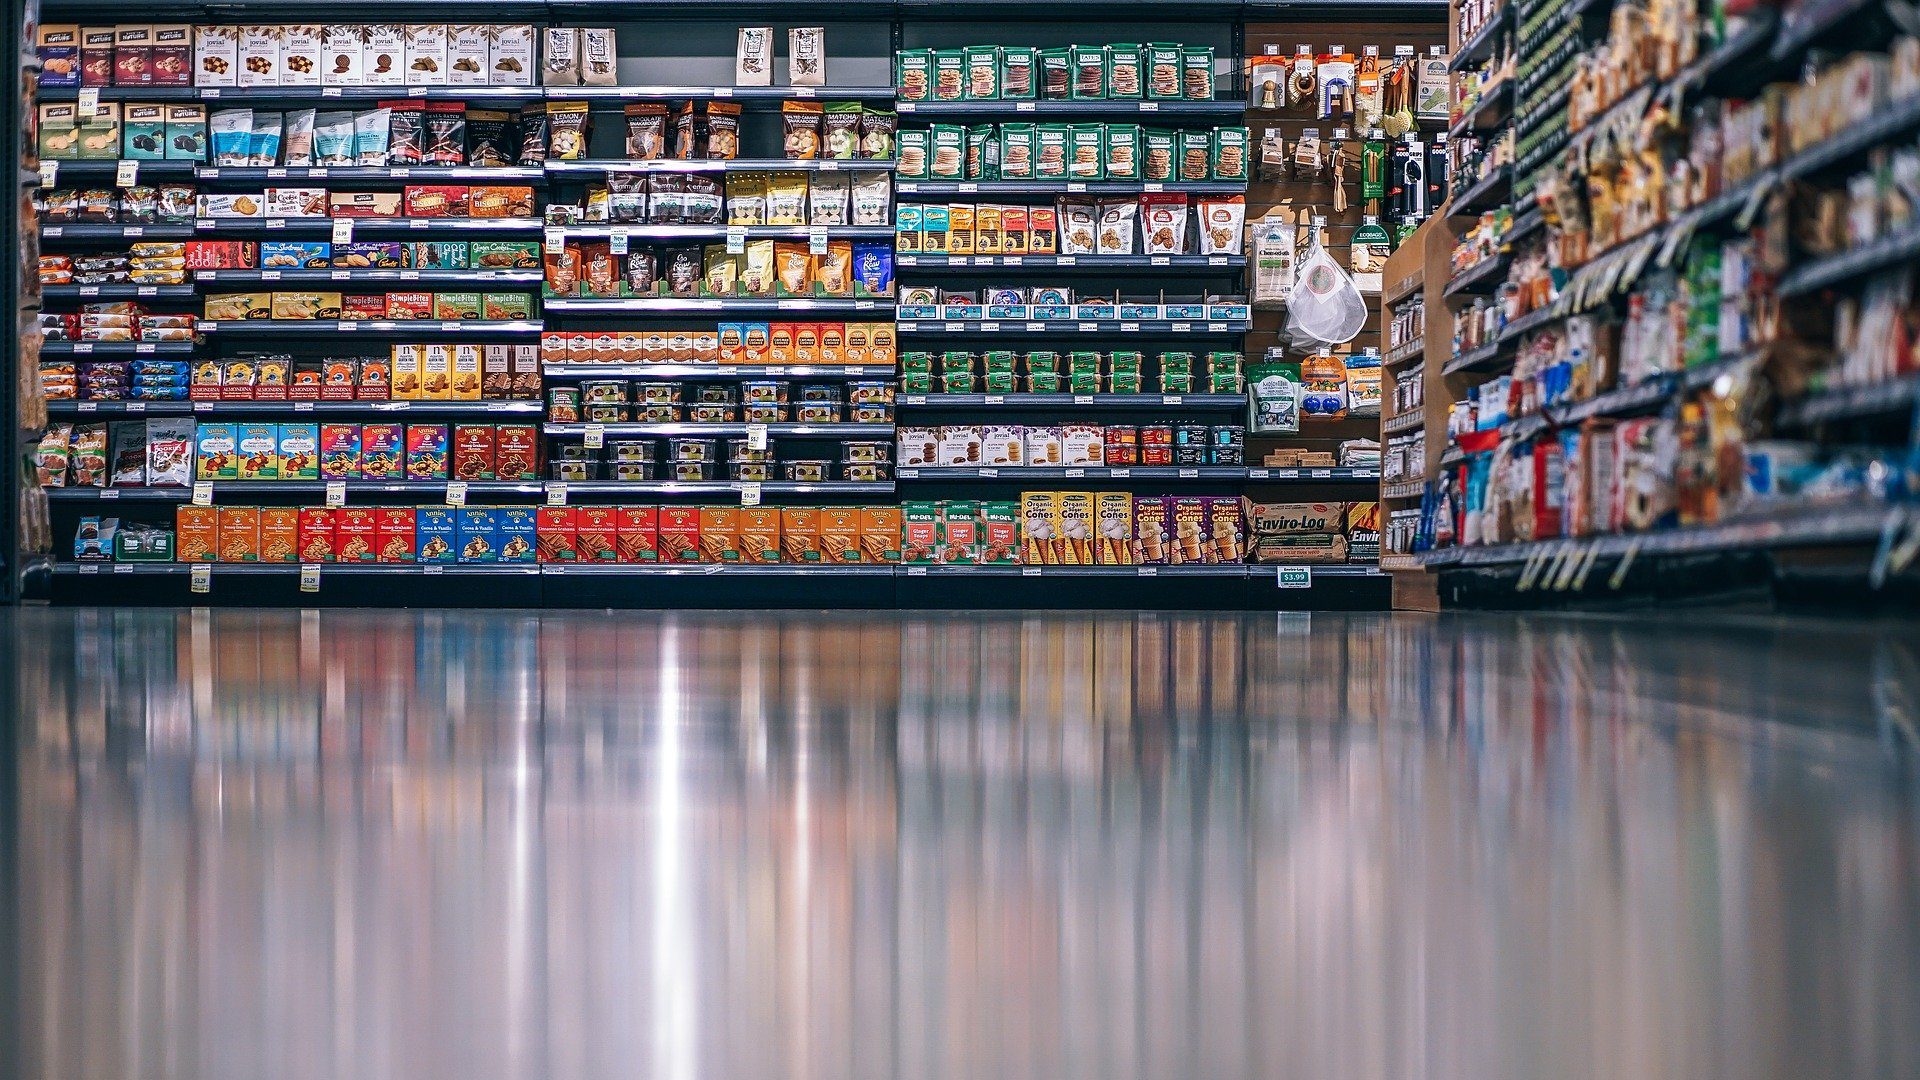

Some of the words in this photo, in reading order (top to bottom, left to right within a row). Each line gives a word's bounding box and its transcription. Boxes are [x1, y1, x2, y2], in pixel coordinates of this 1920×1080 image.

[291, 38, 309, 46] jovial
[333, 38, 351, 46] jovial
[375, 38, 393, 46] jovial
[417, 38, 435, 46] jovial
[459, 38, 478, 47] jovial
[502, 38, 520, 46] jovial
[411, 198, 446, 207] BISCOTTI
[474, 198, 508, 207] BISCOTTI
[346, 296, 383, 304] SimpleBites
[391, 294, 429, 302] SimpleBites
[440, 294, 477, 302] SimpleBites
[487, 294, 525, 302] SimpleBites
[953, 432, 968, 440] jovial
[1026, 501, 1053, 509] Organic
[1062, 501, 1088, 509] Organic
[1101, 501, 1127, 509] Organic
[1138, 504, 1164, 512] Organic
[1176, 504, 1203, 512] Organic
[1213, 504, 1239, 512] Organic
[1025, 510, 1053, 519] Cones
[1061, 510, 1089, 519] Cones
[1100, 510, 1127, 519] Cones
[1137, 513, 1165, 522] Cones
[1175, 513, 1203, 522] Cones
[1212, 513, 1239, 522] Cones
[1256, 515, 1327, 531] Enviro-Log
[1284, 573, 1305, 581] $3.99
